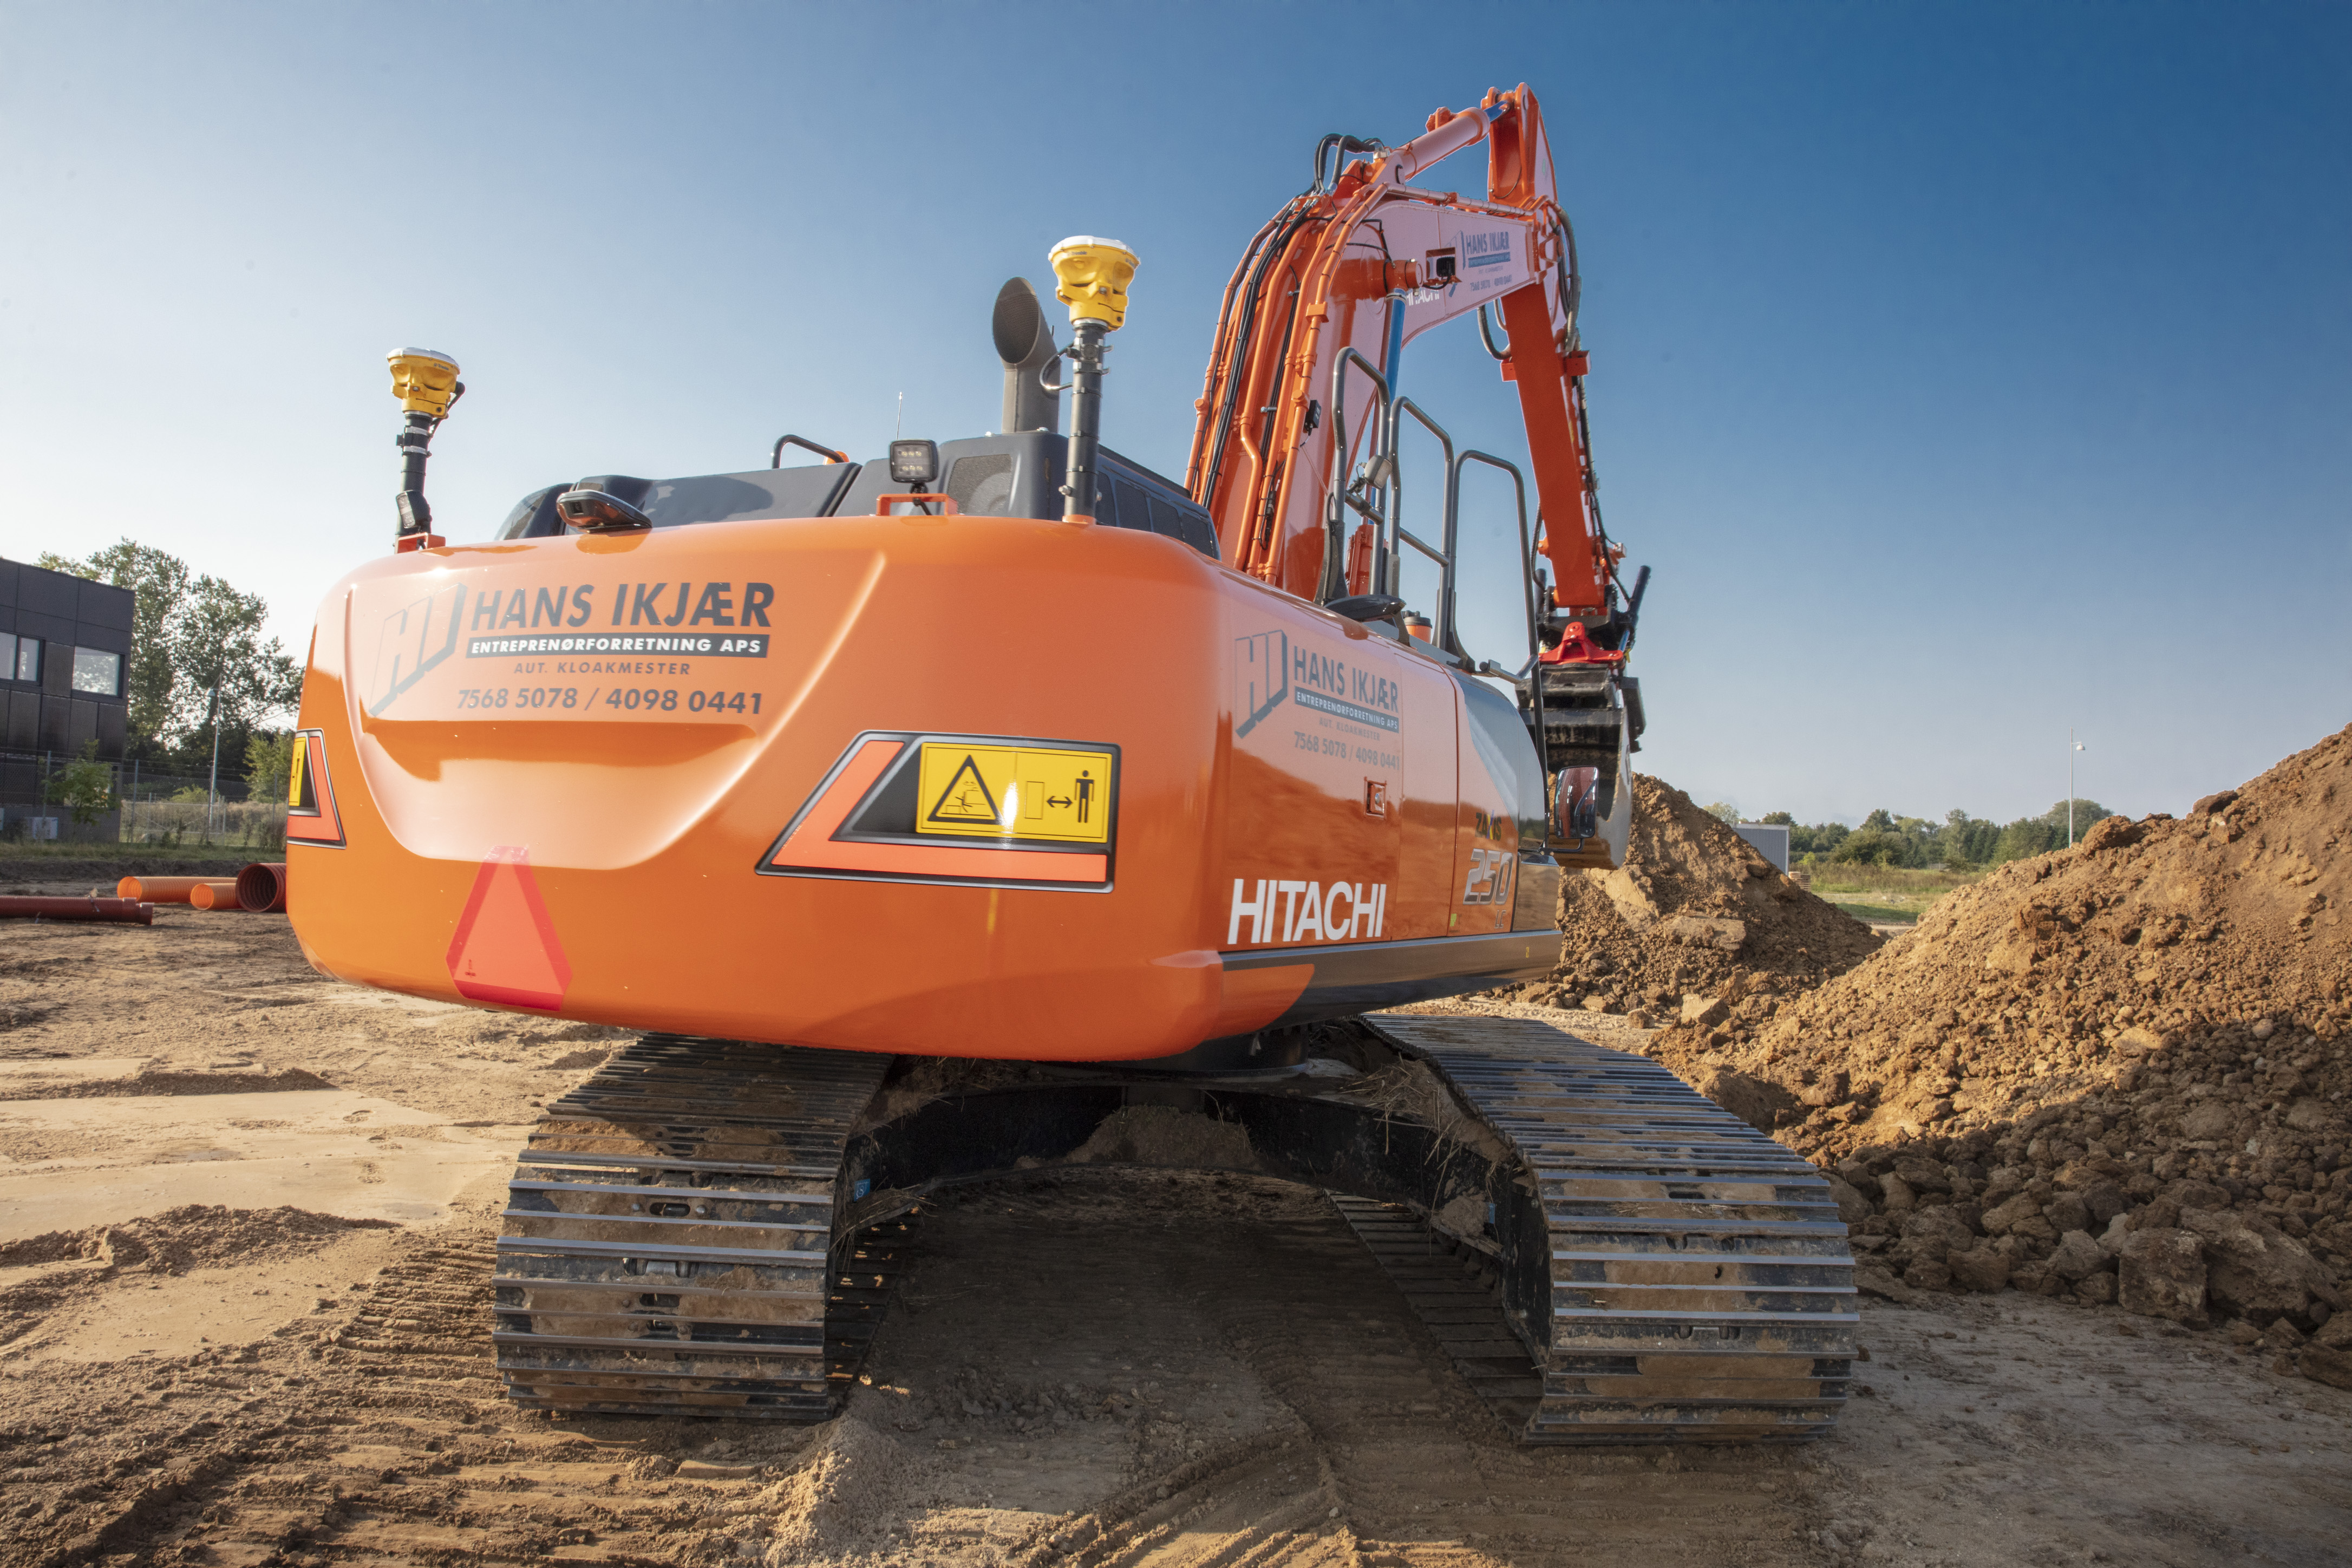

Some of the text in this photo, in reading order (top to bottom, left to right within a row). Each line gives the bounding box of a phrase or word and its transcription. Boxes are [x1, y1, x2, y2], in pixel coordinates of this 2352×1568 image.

[1466, 233, 1487, 254] HANS
[471, 582, 775, 631] HANS IKJÆR
[471, 638, 761, 654] ENTREPRENØRFORRETNING APS
[513, 662, 690, 675] AUT. KLOAKMESTER
[1294, 645, 1399, 713] HANS IKJÆR
[457, 687, 762, 715] 7568 5078 / 4098 0441
[1386, 718, 1398, 729] APS
[1294, 730, 1319, 753] 7568
[1322, 737, 1347, 759] 5078
[1356, 746, 1378, 766] 4098
[1381, 752, 1400, 771] 0441
[1475, 810, 1502, 841] ZAXIS
[1463, 848, 1513, 906] 250
[1227, 878, 1387, 945] HITACHI
